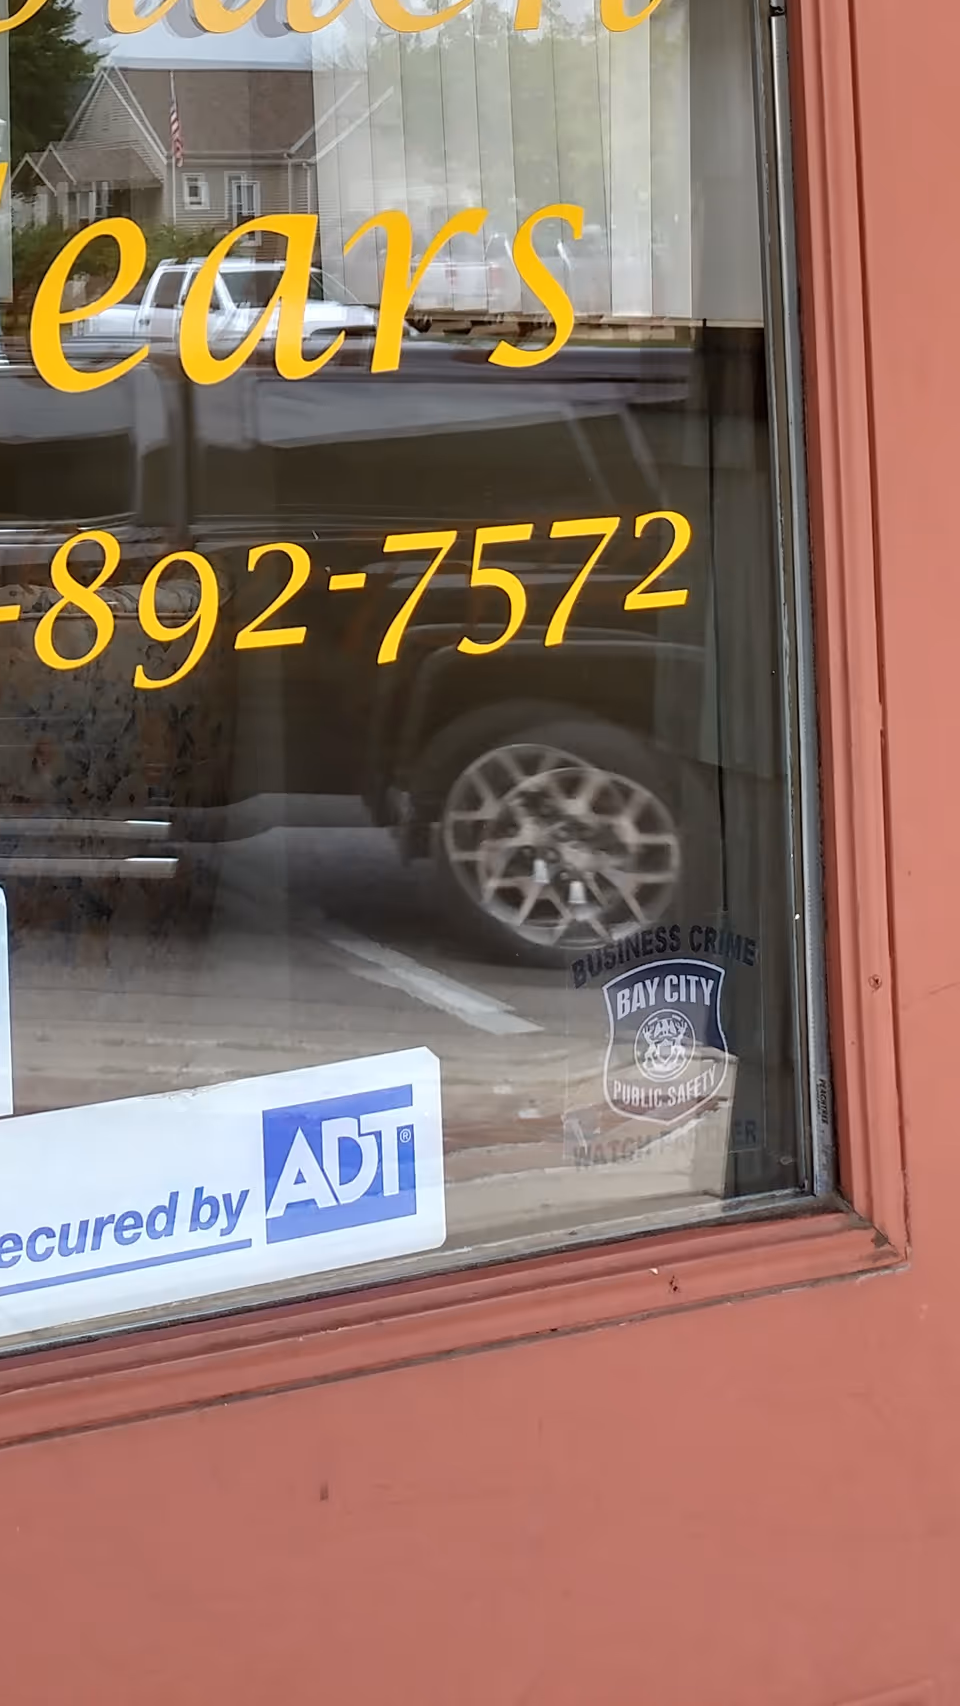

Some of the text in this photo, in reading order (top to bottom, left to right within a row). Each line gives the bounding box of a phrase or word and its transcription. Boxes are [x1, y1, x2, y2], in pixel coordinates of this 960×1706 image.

[571, 924, 757, 989] BUSINESS CRIME
[616, 974, 715, 1020] BAY CITY
[612, 1067, 717, 1109] PUBLIC SAFETY
[188, 1186, 250, 1235] by
